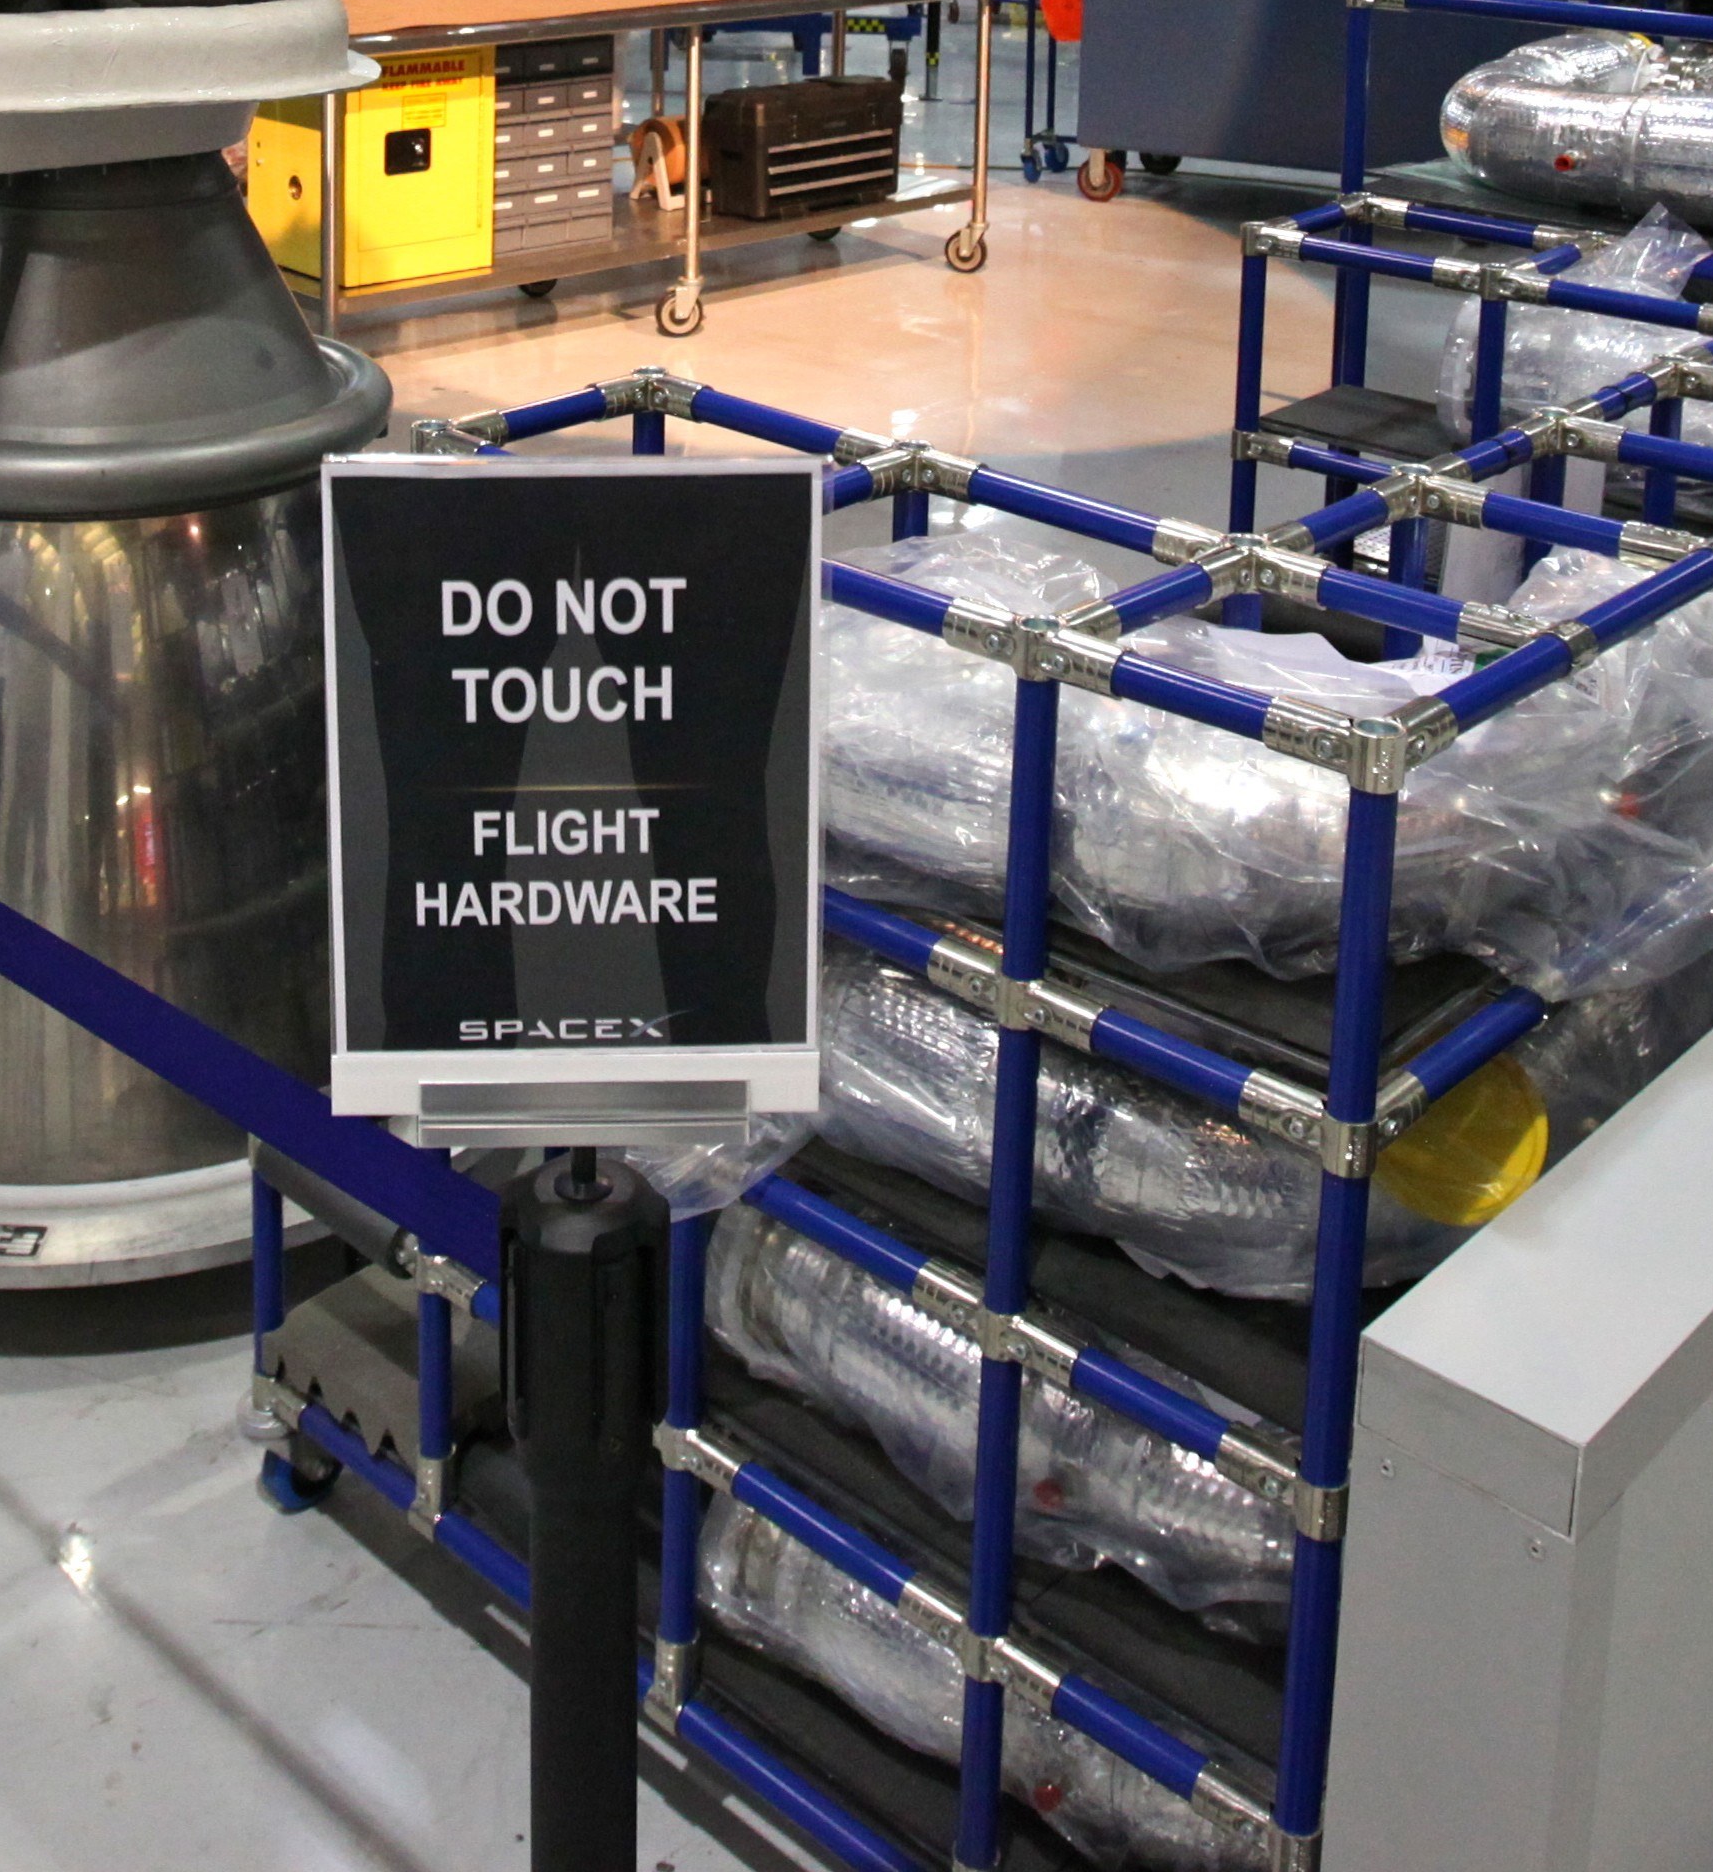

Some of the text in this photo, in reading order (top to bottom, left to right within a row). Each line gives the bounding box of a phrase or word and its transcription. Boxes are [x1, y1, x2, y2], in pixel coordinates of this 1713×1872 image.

[382, 60, 465, 78] FLAMMABLE
[441, 577, 687, 636] DO NOT
[451, 665, 673, 723] TOUCH
[473, 808, 660, 856] FLIGHT
[415, 878, 718, 926] HARDWARE
[459, 1015, 672, 1042] SPACEX
